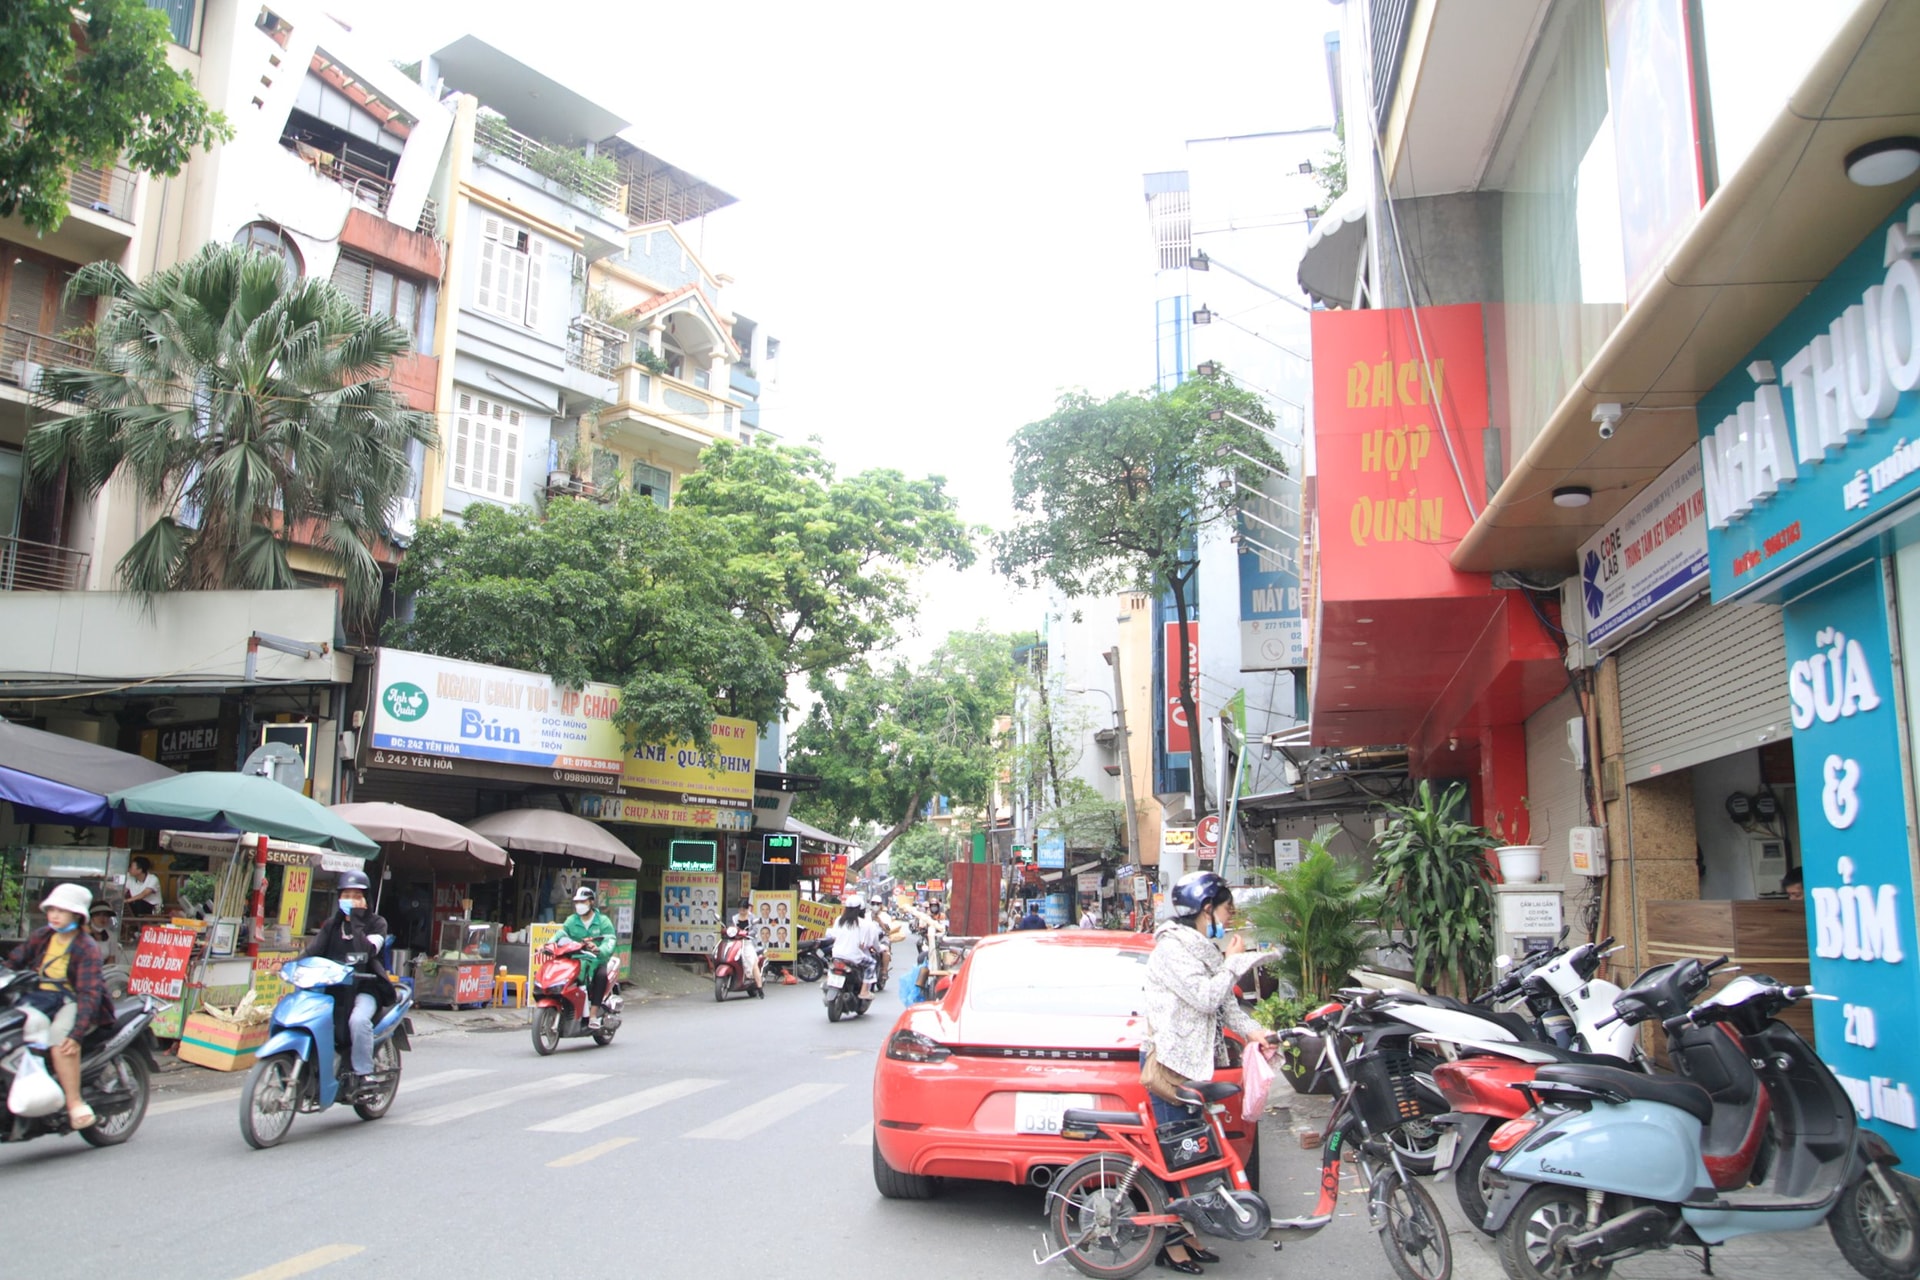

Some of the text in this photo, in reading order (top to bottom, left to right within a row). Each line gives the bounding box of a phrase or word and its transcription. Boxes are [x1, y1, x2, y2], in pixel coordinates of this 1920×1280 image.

[1347, 351, 1445, 409] BÁCH
[1361, 424, 1431, 481] HỢP
[1701, 360, 1798, 531] NHÀ
[1350, 488, 1443, 547] QUÁN
[1600, 528, 1622, 561] CORE
[1624, 539, 1642, 570] TRUNG
[1652, 519, 1664, 549] XÉT
[1663, 501, 1688, 540] NGHIỆM
[1602, 553, 1619, 583] LAB
[1252, 584, 1283, 613] MÁY
[436, 672, 481, 704] NGAN
[1790, 626, 1880, 729] SỮA
[387, 688, 407, 703] Anh
[460, 708, 521, 744] Bún
[563, 732, 587, 742] NGAN
[407, 740, 423, 749] 242
[425, 740, 441, 751] YÊN
[540, 741, 562, 751] TRỘN
[387, 754, 453, 770] 242 YÊN HÒA
[720, 756, 751, 773] PHIM
[564, 773, 614, 785] 0989010032
[1822, 754, 1861, 829] &
[624, 806, 648, 820] CHỤP
[651, 803, 669, 819] ẢNH
[671, 806, 688, 821] THẺ
[807, 867, 828, 875] 10K
[820, 856, 830, 865] XE
[1811, 855, 1903, 964] BỈM
[136, 952, 153, 968] CHÈ
[164, 958, 184, 971] ĐEN
[459, 975, 479, 997] NỘM
[1843, 1003, 1877, 1048] 210
[1004, 1049, 1109, 1059] PORSCHE
[1329, 1131, 1342, 1151] PEGA
[1538, 1158, 1584, 1178] Vespa
